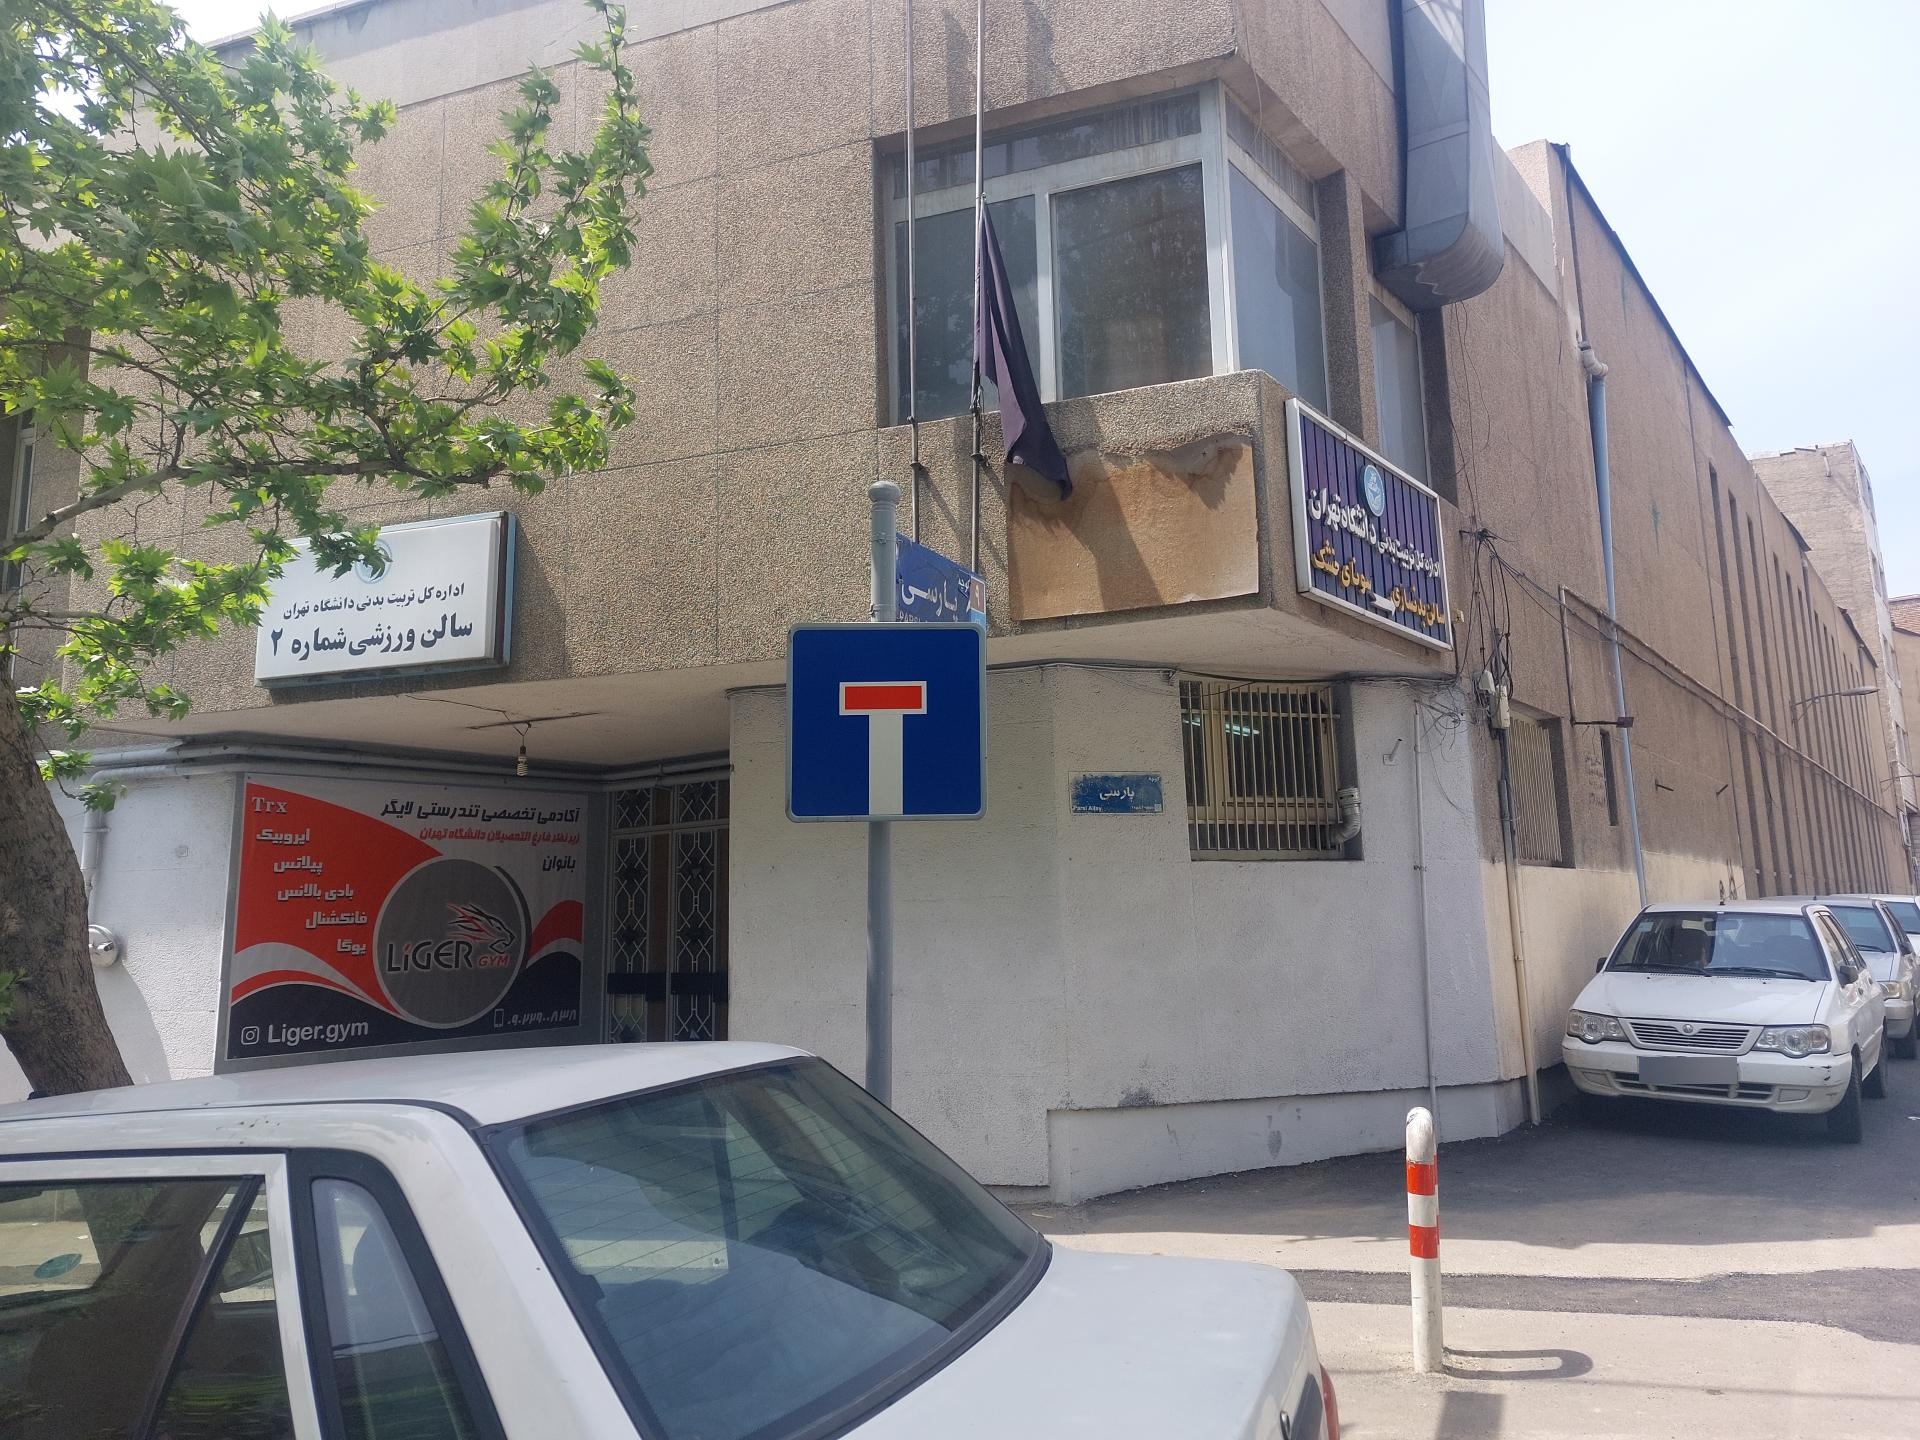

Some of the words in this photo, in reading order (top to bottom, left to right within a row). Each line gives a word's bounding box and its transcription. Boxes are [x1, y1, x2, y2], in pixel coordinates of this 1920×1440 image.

[1307, 487, 1341, 532] تهران
[1340, 503, 1377, 545] دانشگاه
[1377, 527, 1396, 564] بدنی
[1311, 539, 1340, 577] خشک
[1395, 540, 1415, 570] تربیت
[1341, 556, 1372, 595] سونای
[387, 589, 415, 607] تربیت
[417, 586, 434, 604] کل
[435, 582, 465, 599] اداره
[313, 597, 355, 614] دانشگاه
[356, 595, 384, 611] بدنی
[901, 579, 959, 622] پارسی
[283, 600, 310, 620] تهران
[1425, 602, 1446, 626] سالن
[420, 612, 473, 647] سالن
[270, 627, 283, 657] ۲
[291, 625, 347, 661] شماره
[348, 622, 416, 656] ورزشی
[1099, 786, 1135, 803] پارسی
[251, 796, 288, 813] Trx
[380, 799, 414, 818] لایگر
[416, 802, 480, 819] تندرستی
[481, 807, 536, 822] تخصصی
[537, 807, 581, 825] آکادمی
[255, 827, 311, 845] ایروبیک
[419, 826, 448, 841] تهران
[448, 826, 486, 840] دانشگاه
[486, 829, 531, 843] التحصیلان
[531, 831, 551, 847] فارغ
[273, 855, 323, 875] پیلاتس
[542, 855, 576, 872] بانوان
[277, 883, 322, 901] بالانس
[324, 883, 354, 901] بادی
[305, 910, 368, 929] فانکشنال
[336, 938, 367, 955] یوگا
[478, 955, 510, 967] GYM
[267, 1019, 370, 1047] Liger.gym
